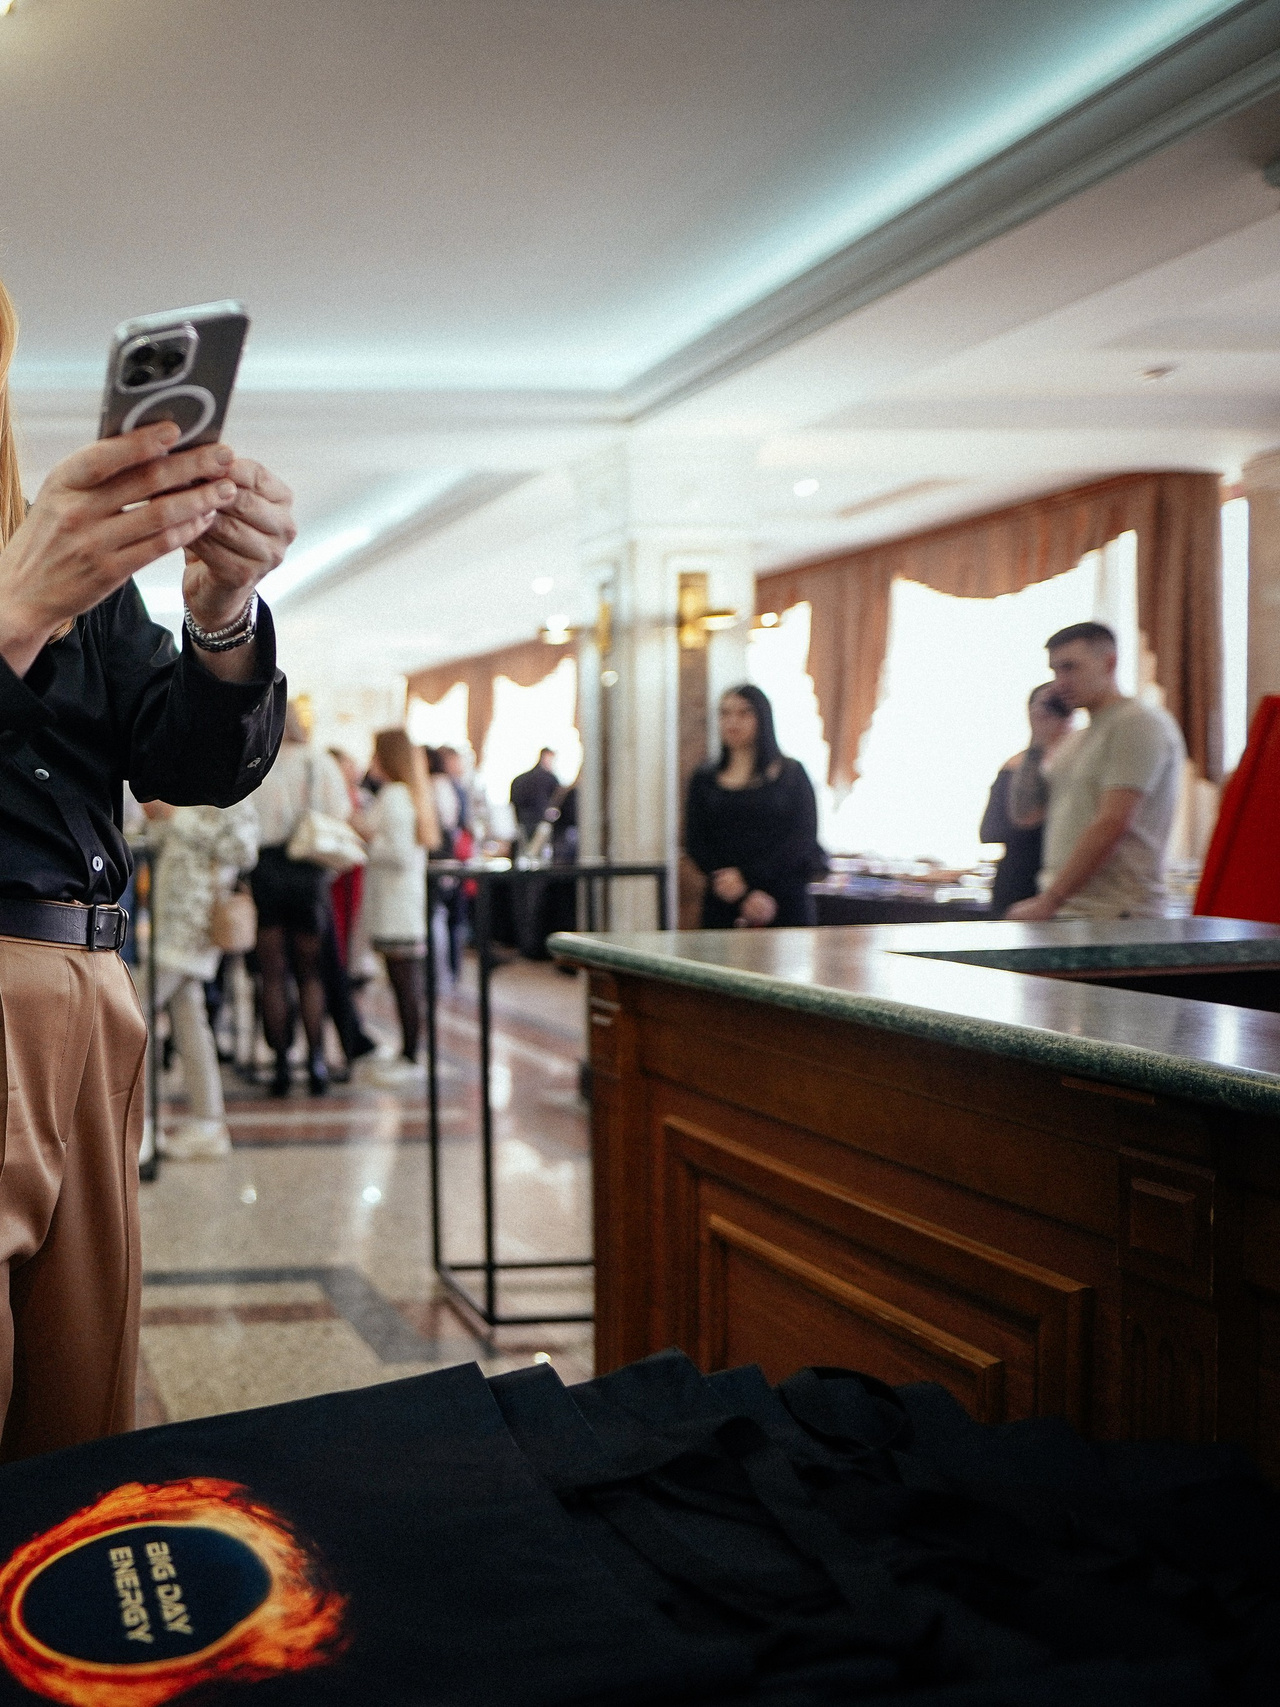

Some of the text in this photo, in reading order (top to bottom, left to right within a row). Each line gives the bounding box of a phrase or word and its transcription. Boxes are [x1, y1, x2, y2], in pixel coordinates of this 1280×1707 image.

[109, 1545, 154, 1644] ENERGY
[145, 1541, 193, 1635] BIG DAY
